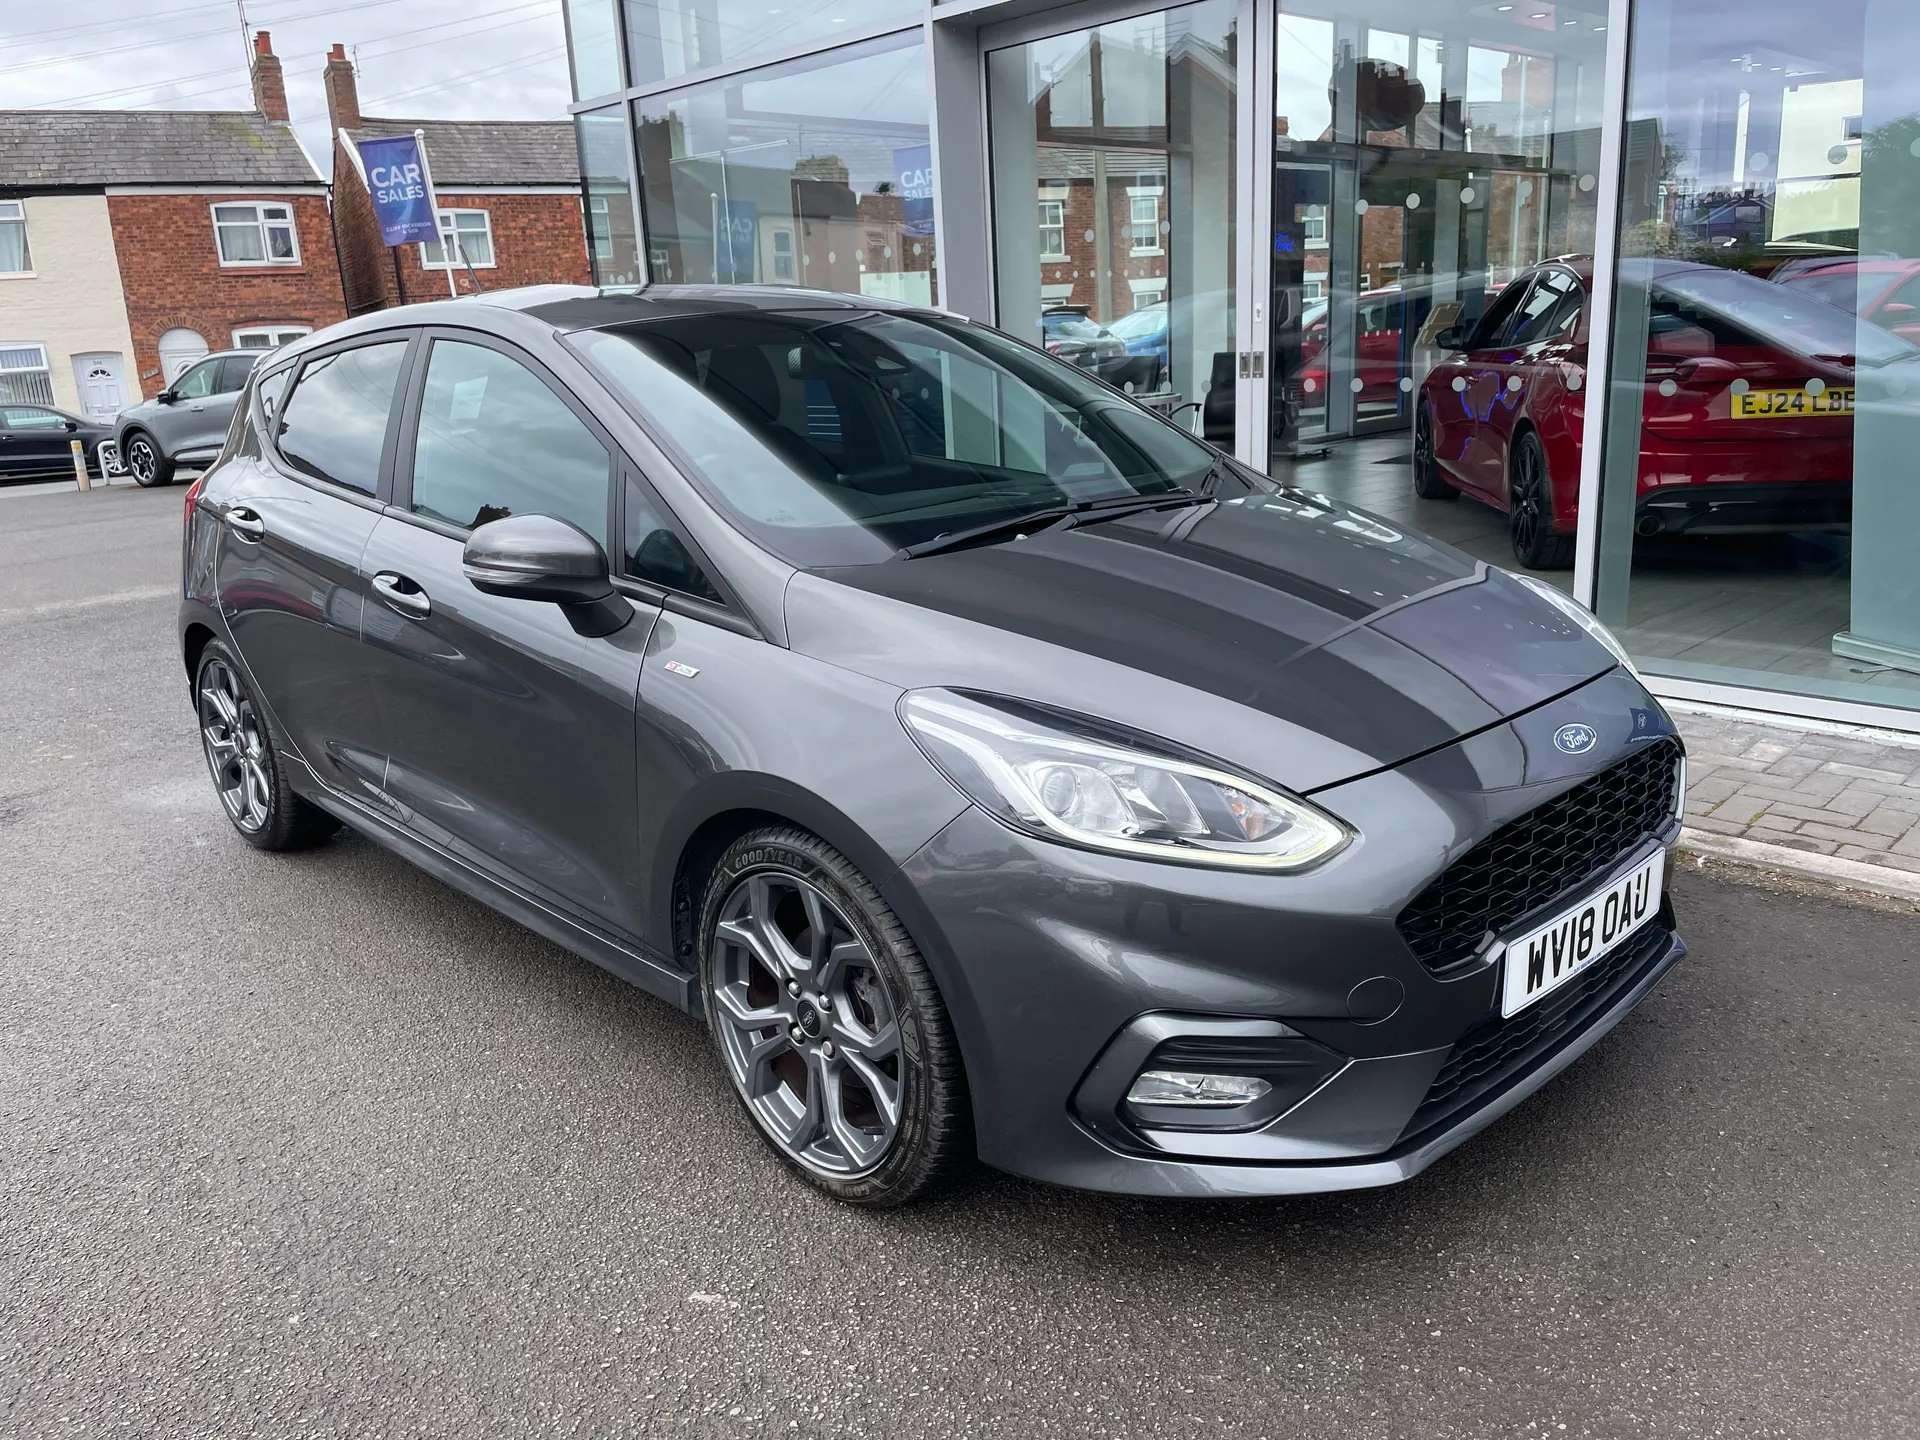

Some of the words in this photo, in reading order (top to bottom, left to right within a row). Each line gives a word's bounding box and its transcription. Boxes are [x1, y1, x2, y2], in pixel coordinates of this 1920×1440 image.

[371, 163, 421, 188] CAR
[377, 185, 424, 204] SALES
[904, 187, 932, 202] SALE
[1742, 391, 1805, 414] EJ24
[735, 848, 801, 869] GOODYEAR
[1526, 906, 1596, 996] WV18
[1601, 866, 1651, 945] OAU
